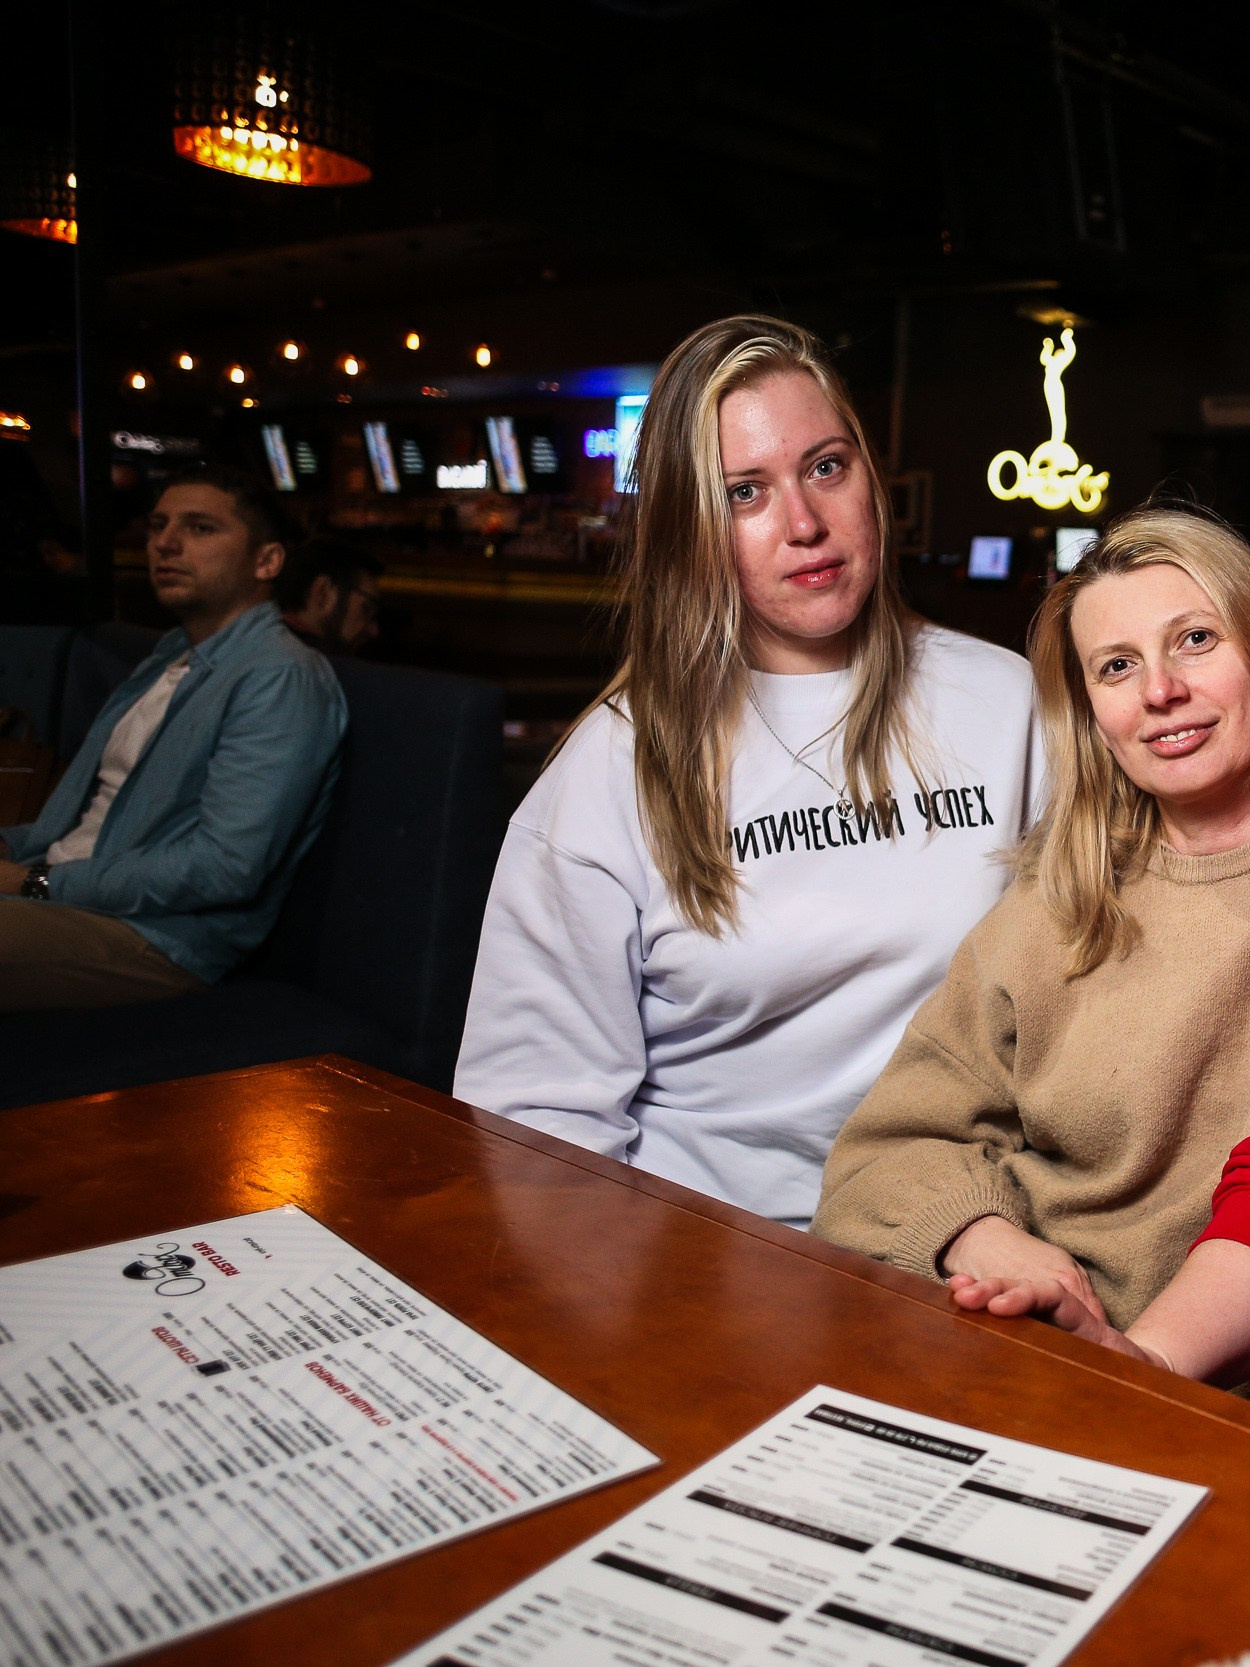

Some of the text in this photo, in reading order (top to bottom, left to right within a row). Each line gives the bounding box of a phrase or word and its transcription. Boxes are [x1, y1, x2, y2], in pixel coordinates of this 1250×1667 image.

[728, 785, 994, 863] ИТИЧЕСКИЙ УСПЕХ
[191, 1241, 241, 1277] RESTO BAR
[304, 1361, 352, 1395] БАРМЕНОВ
[344, 1393, 380, 1418] НАШИХ
